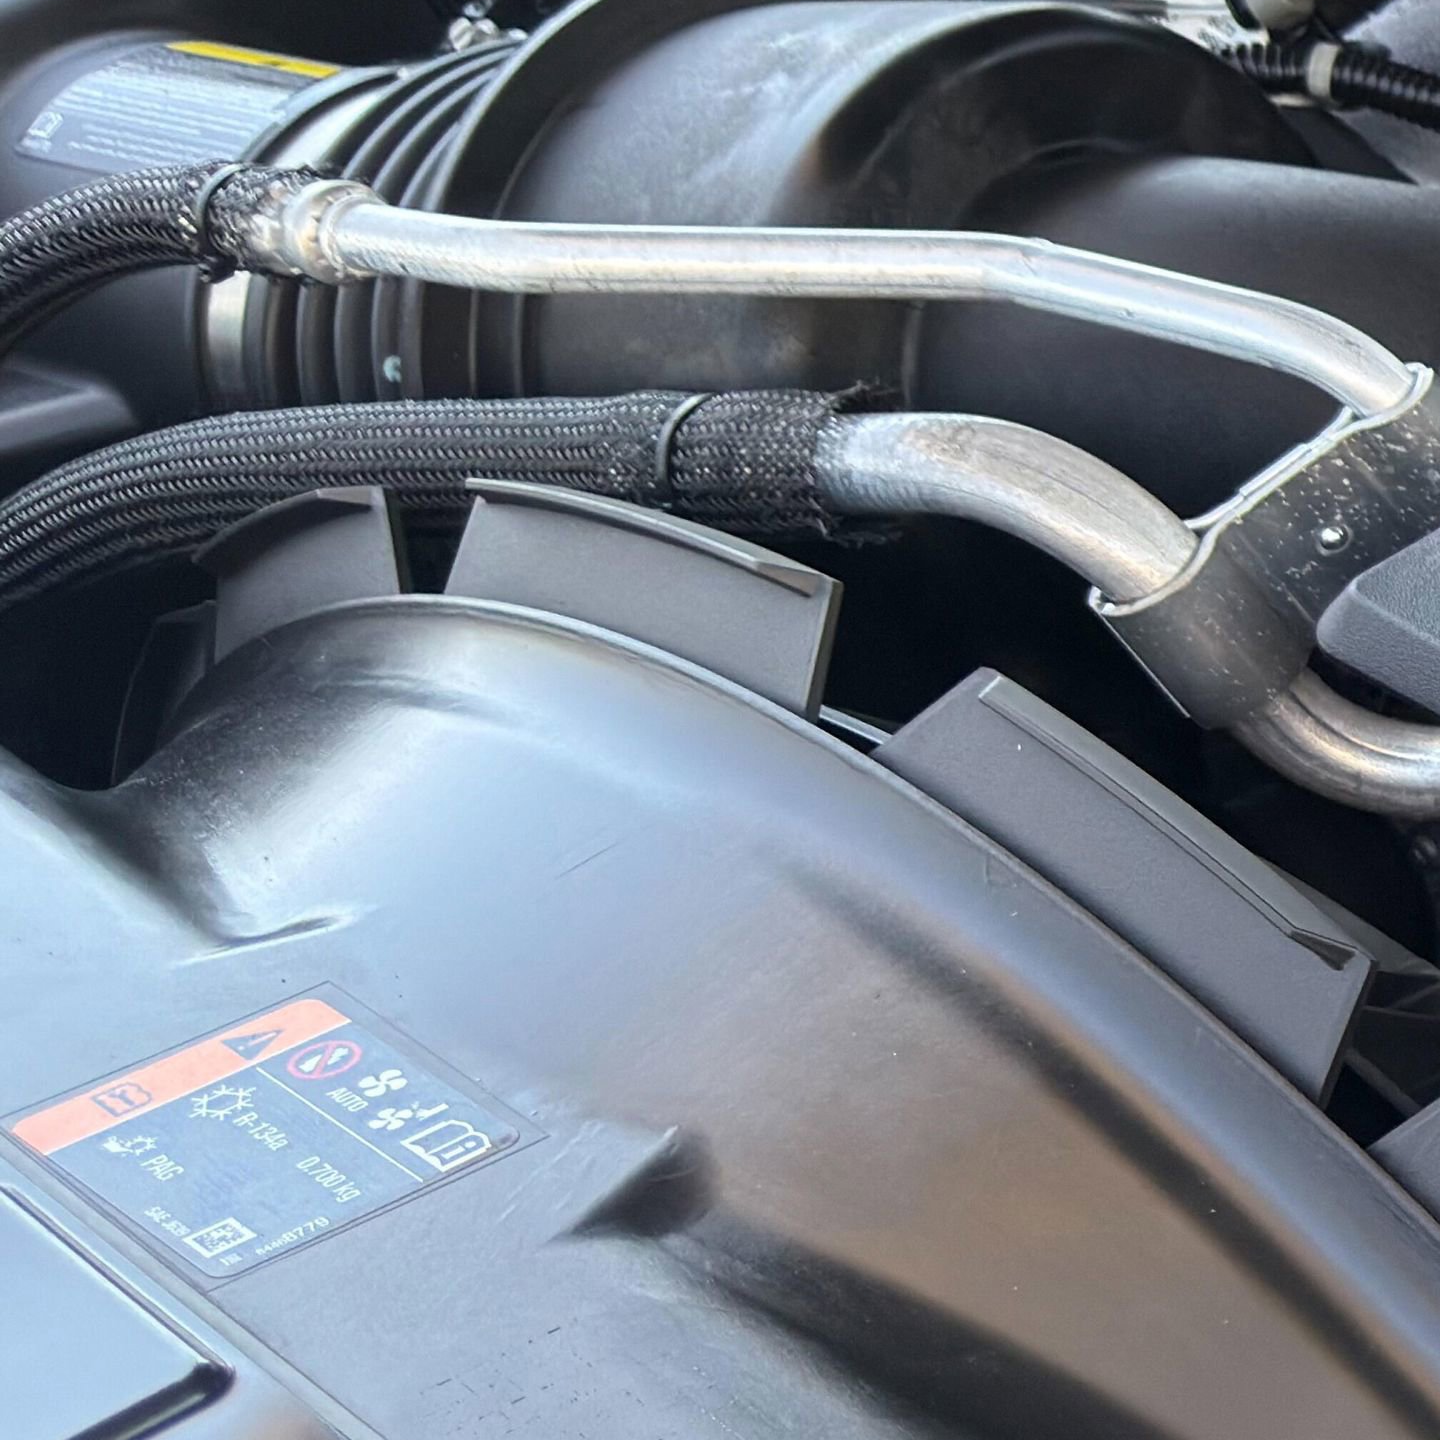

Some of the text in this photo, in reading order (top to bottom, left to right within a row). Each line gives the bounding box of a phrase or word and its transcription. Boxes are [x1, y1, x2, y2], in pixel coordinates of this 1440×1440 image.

[325, 1086, 370, 1114] AUTO
[140, 1153, 185, 1183] PAG
[232, 1112, 362, 1204] R-134a 0.700 kg
